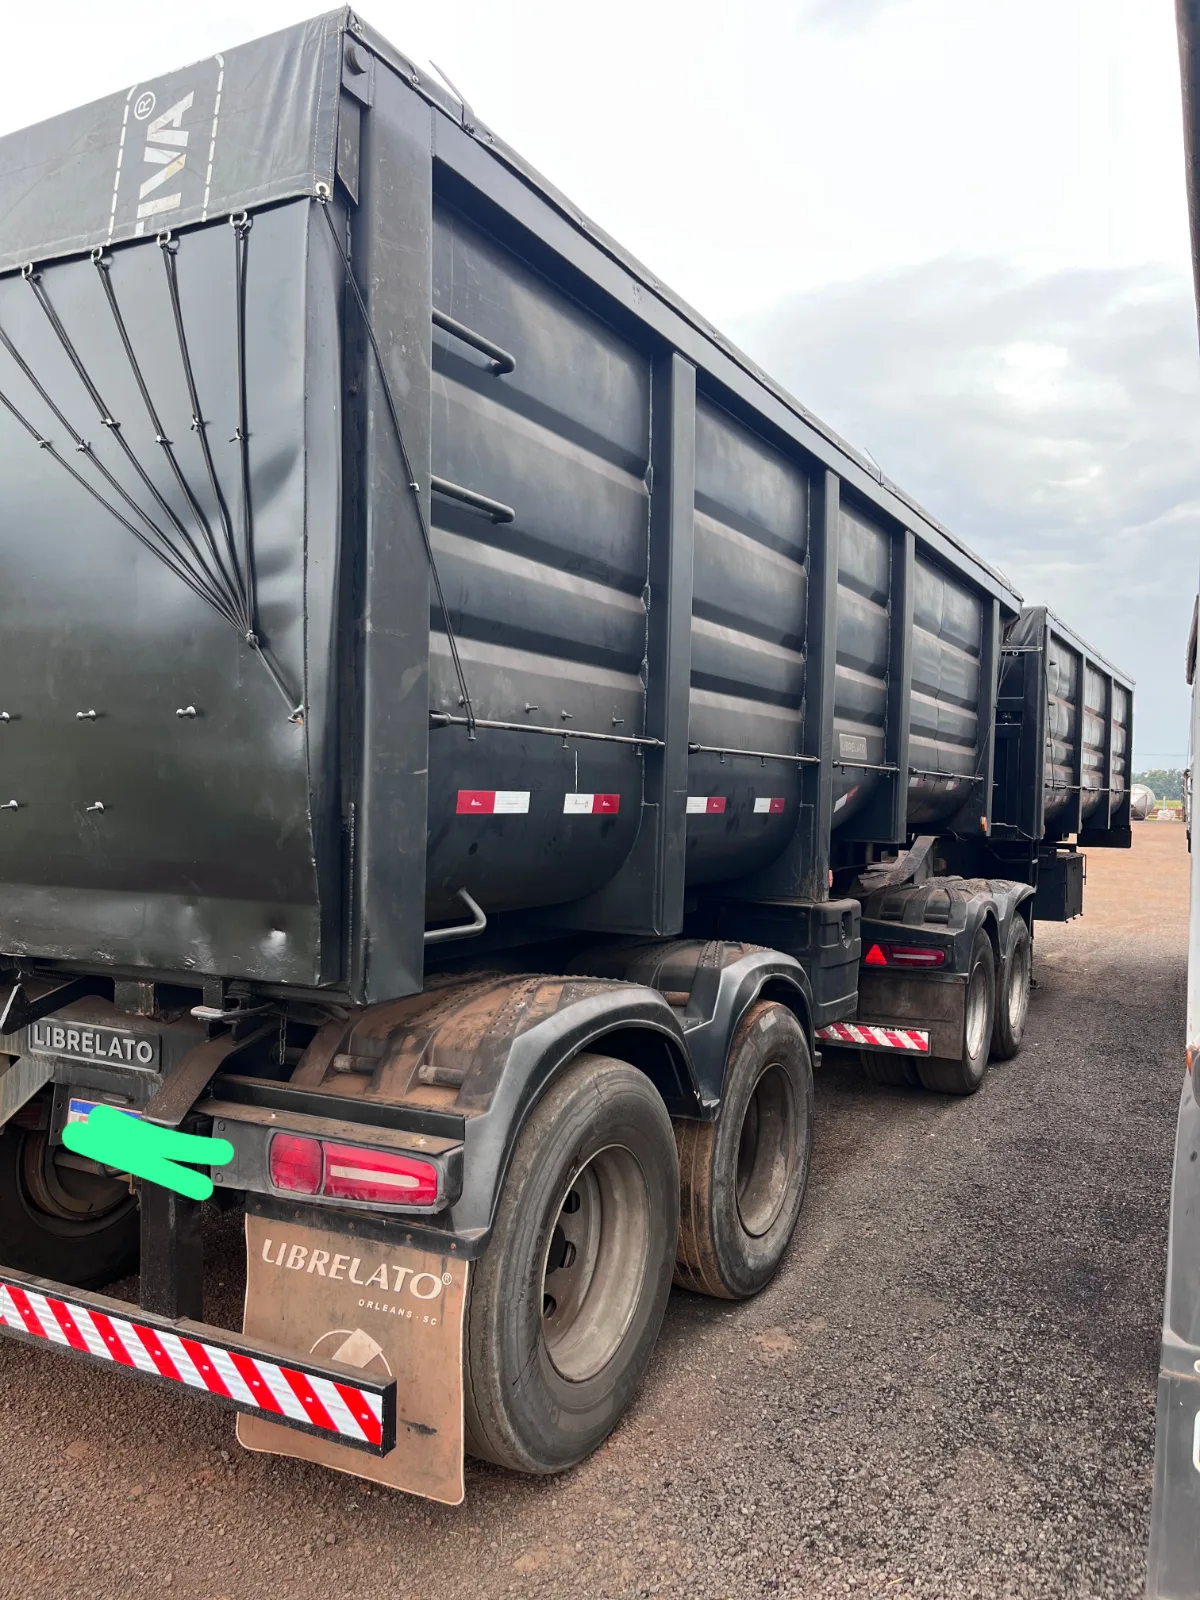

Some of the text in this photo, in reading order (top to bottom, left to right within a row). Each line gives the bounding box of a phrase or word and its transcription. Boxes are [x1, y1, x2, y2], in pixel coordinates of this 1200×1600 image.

[33, 1024, 153, 1063] LIBRELATO
[358, 1298, 413, 1318] ORLEANS
[422, 1315, 438, 1326] SC
